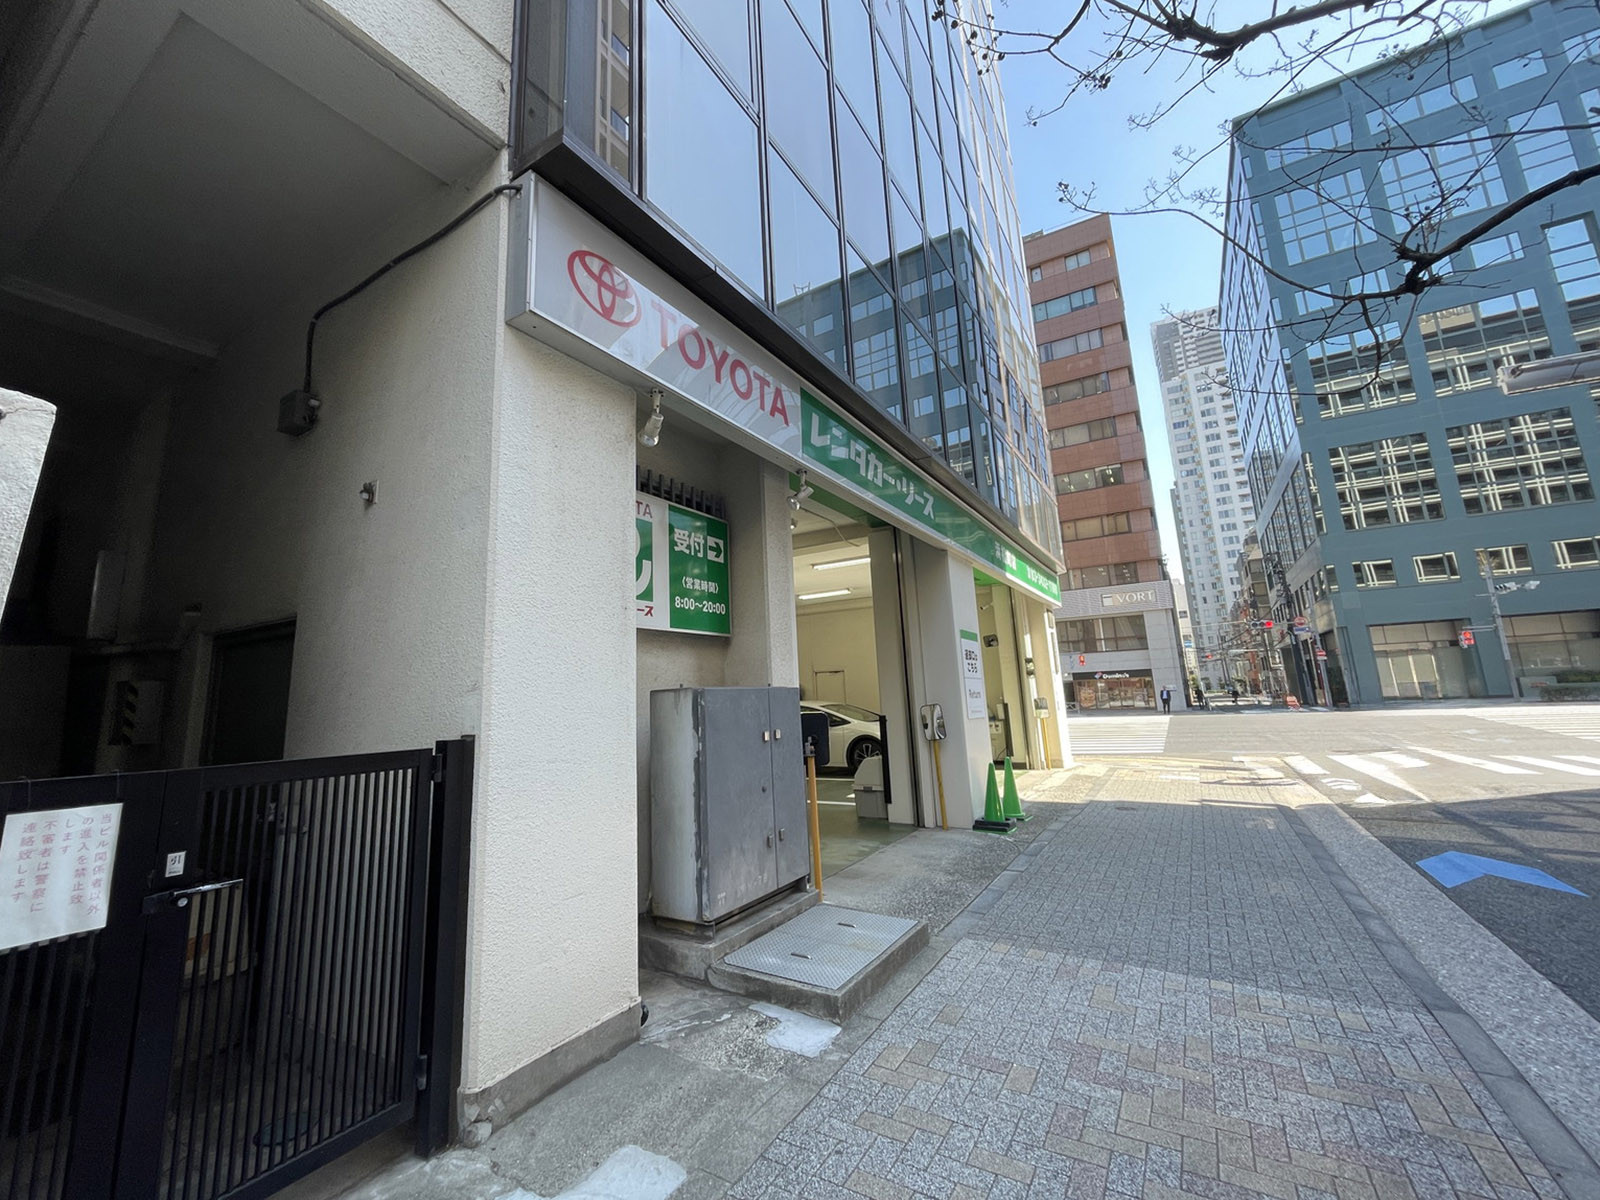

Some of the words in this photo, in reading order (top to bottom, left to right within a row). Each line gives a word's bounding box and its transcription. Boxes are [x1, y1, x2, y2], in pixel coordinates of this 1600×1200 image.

[652, 300, 790, 426] TOYOTA
[636, 501, 653, 519] TA
[674, 528, 705, 558] 受付
[637, 605, 654, 617] ース
[1116, 590, 1154, 603] VORT
[60, 818, 75, 854] します
[87, 813, 112, 915] 当ビル関係者以外
